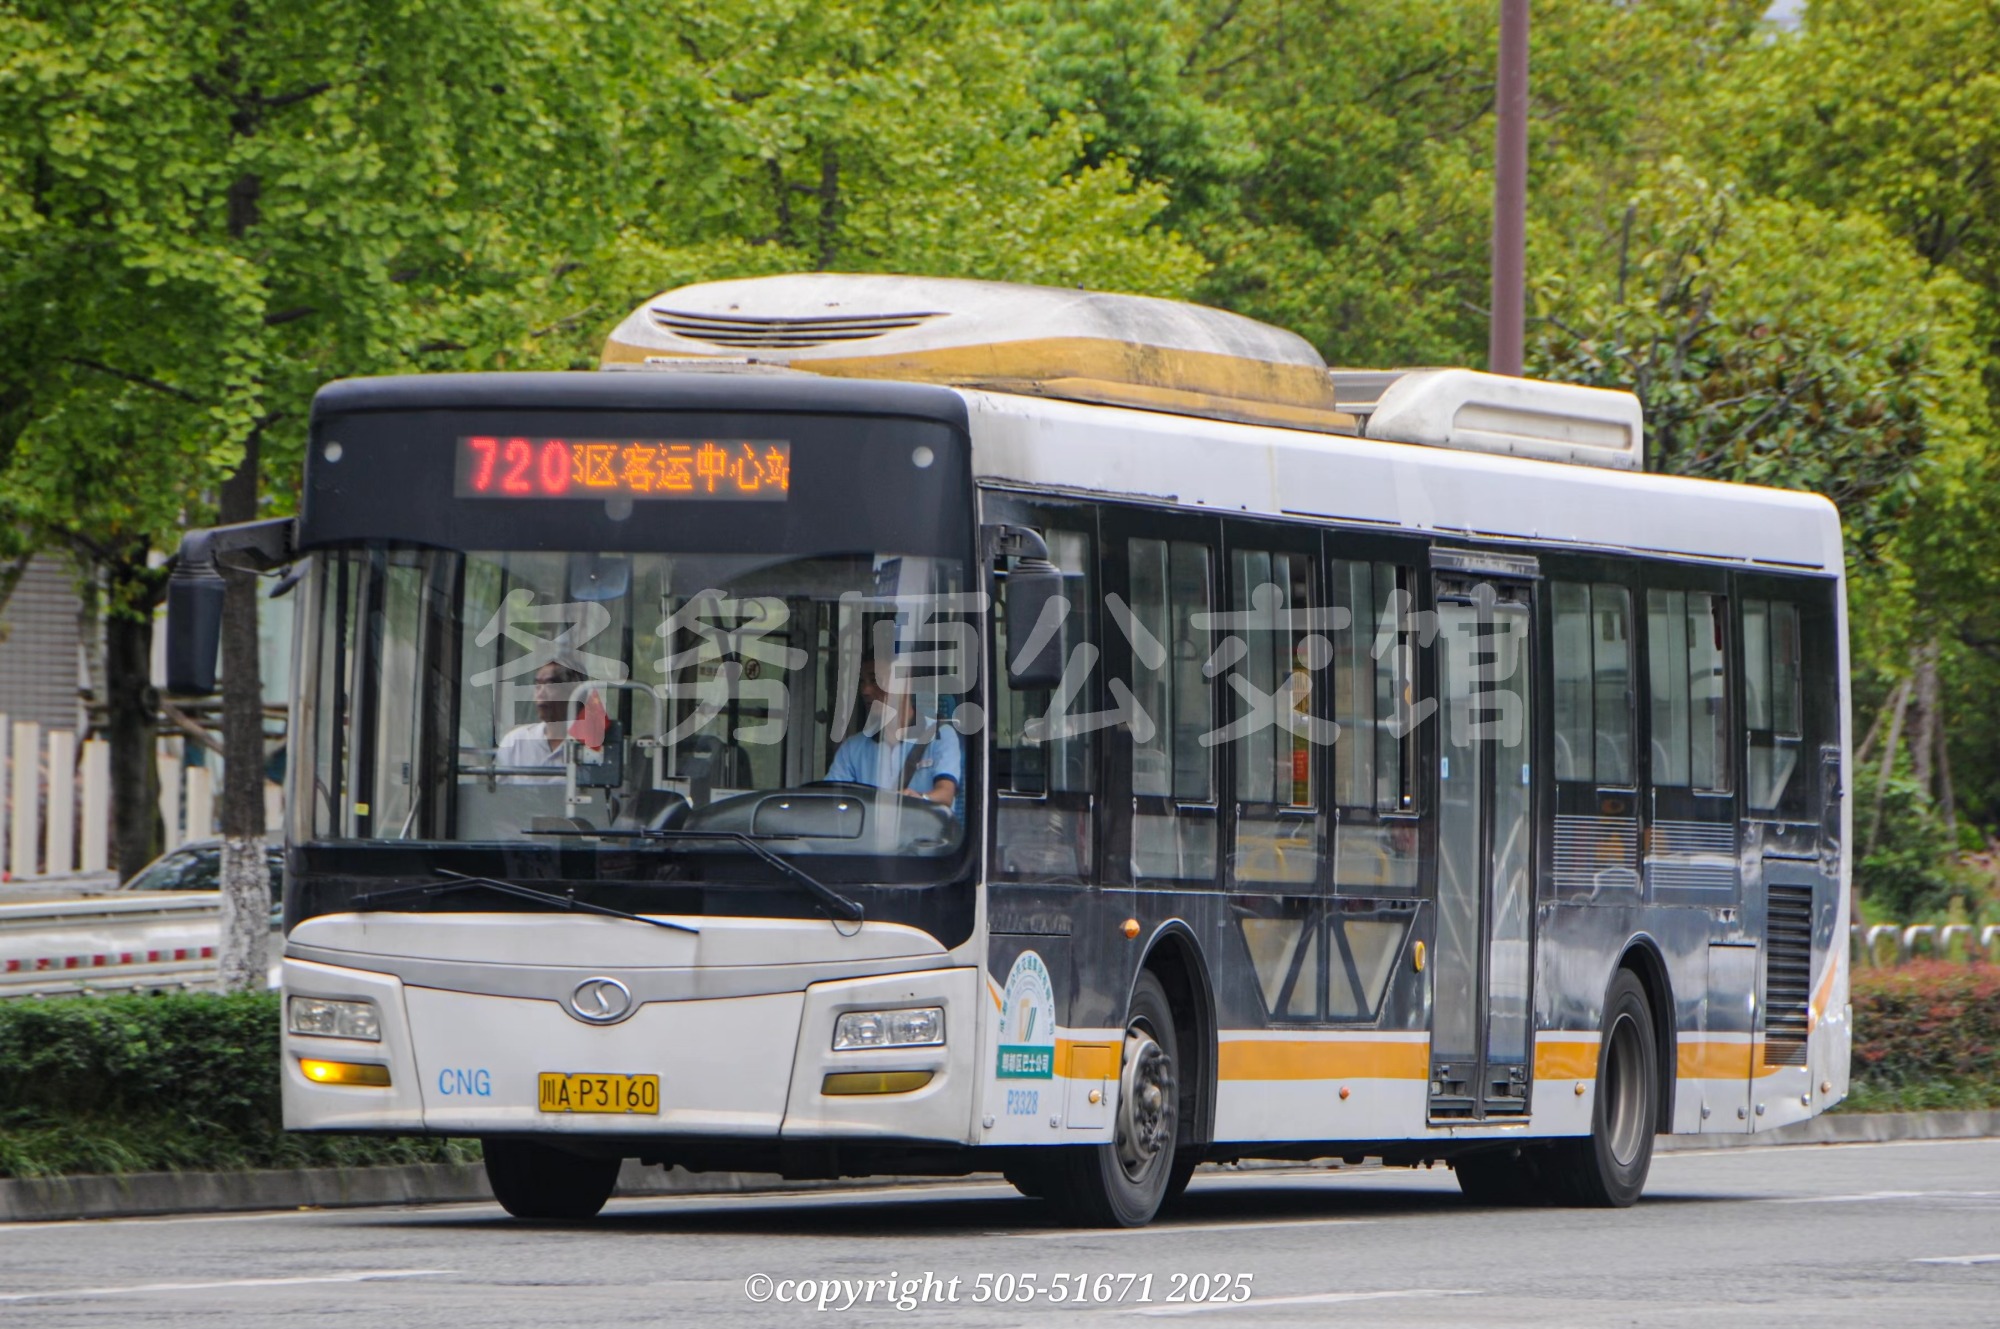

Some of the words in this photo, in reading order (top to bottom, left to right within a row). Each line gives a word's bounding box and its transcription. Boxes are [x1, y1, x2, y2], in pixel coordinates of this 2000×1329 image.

[470, 438, 569, 494] 720
[438, 1069, 492, 1096] CNG
[1007, 1089, 1039, 1115] P3328
